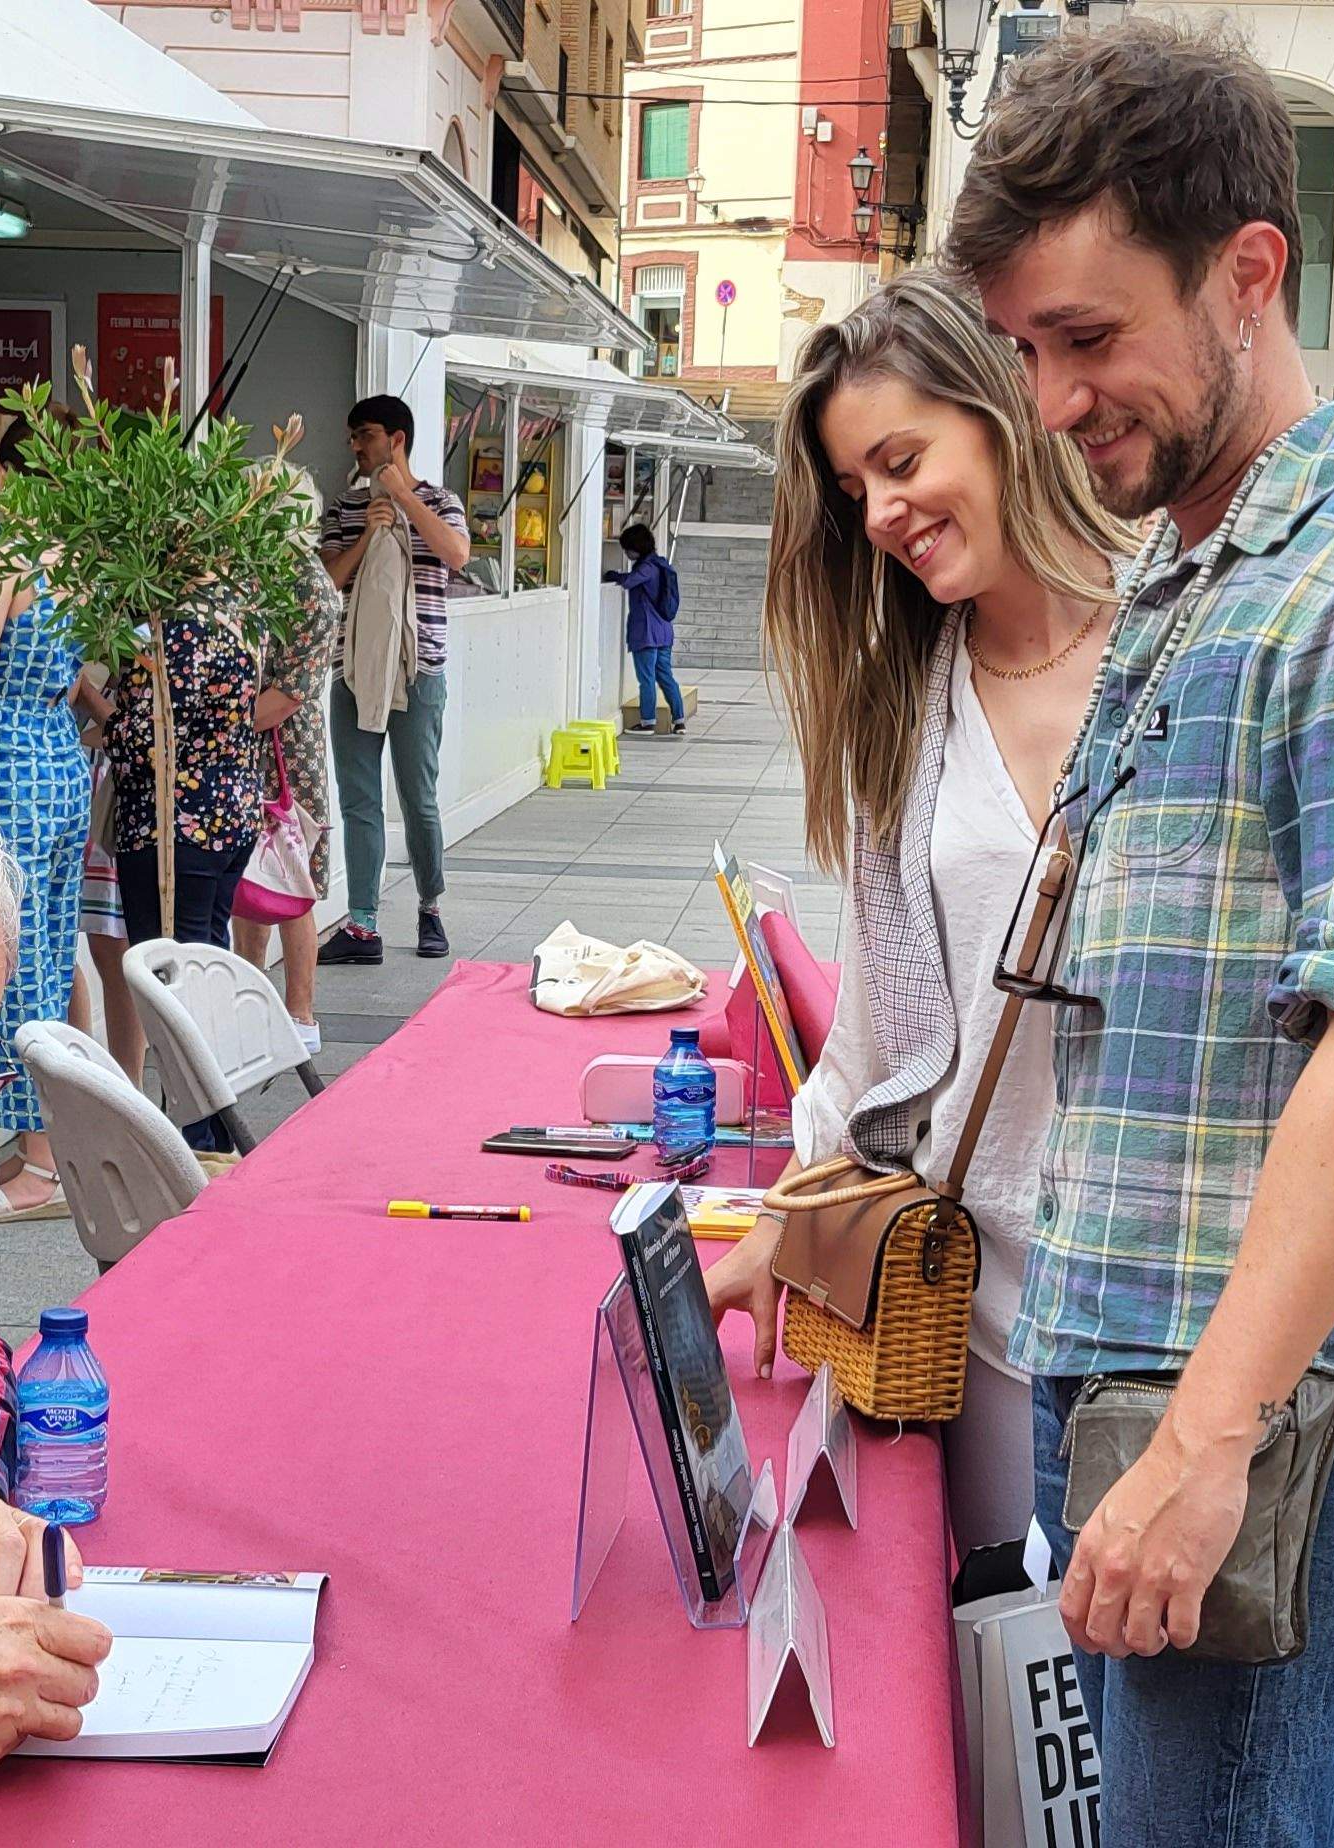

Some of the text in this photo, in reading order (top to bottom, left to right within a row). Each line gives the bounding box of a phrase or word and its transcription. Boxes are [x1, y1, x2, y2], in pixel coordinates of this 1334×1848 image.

[0, 375, 23, 385] ocio
[1025, 1653, 1083, 1729] FE
[1035, 1722, 1100, 1802] DE
